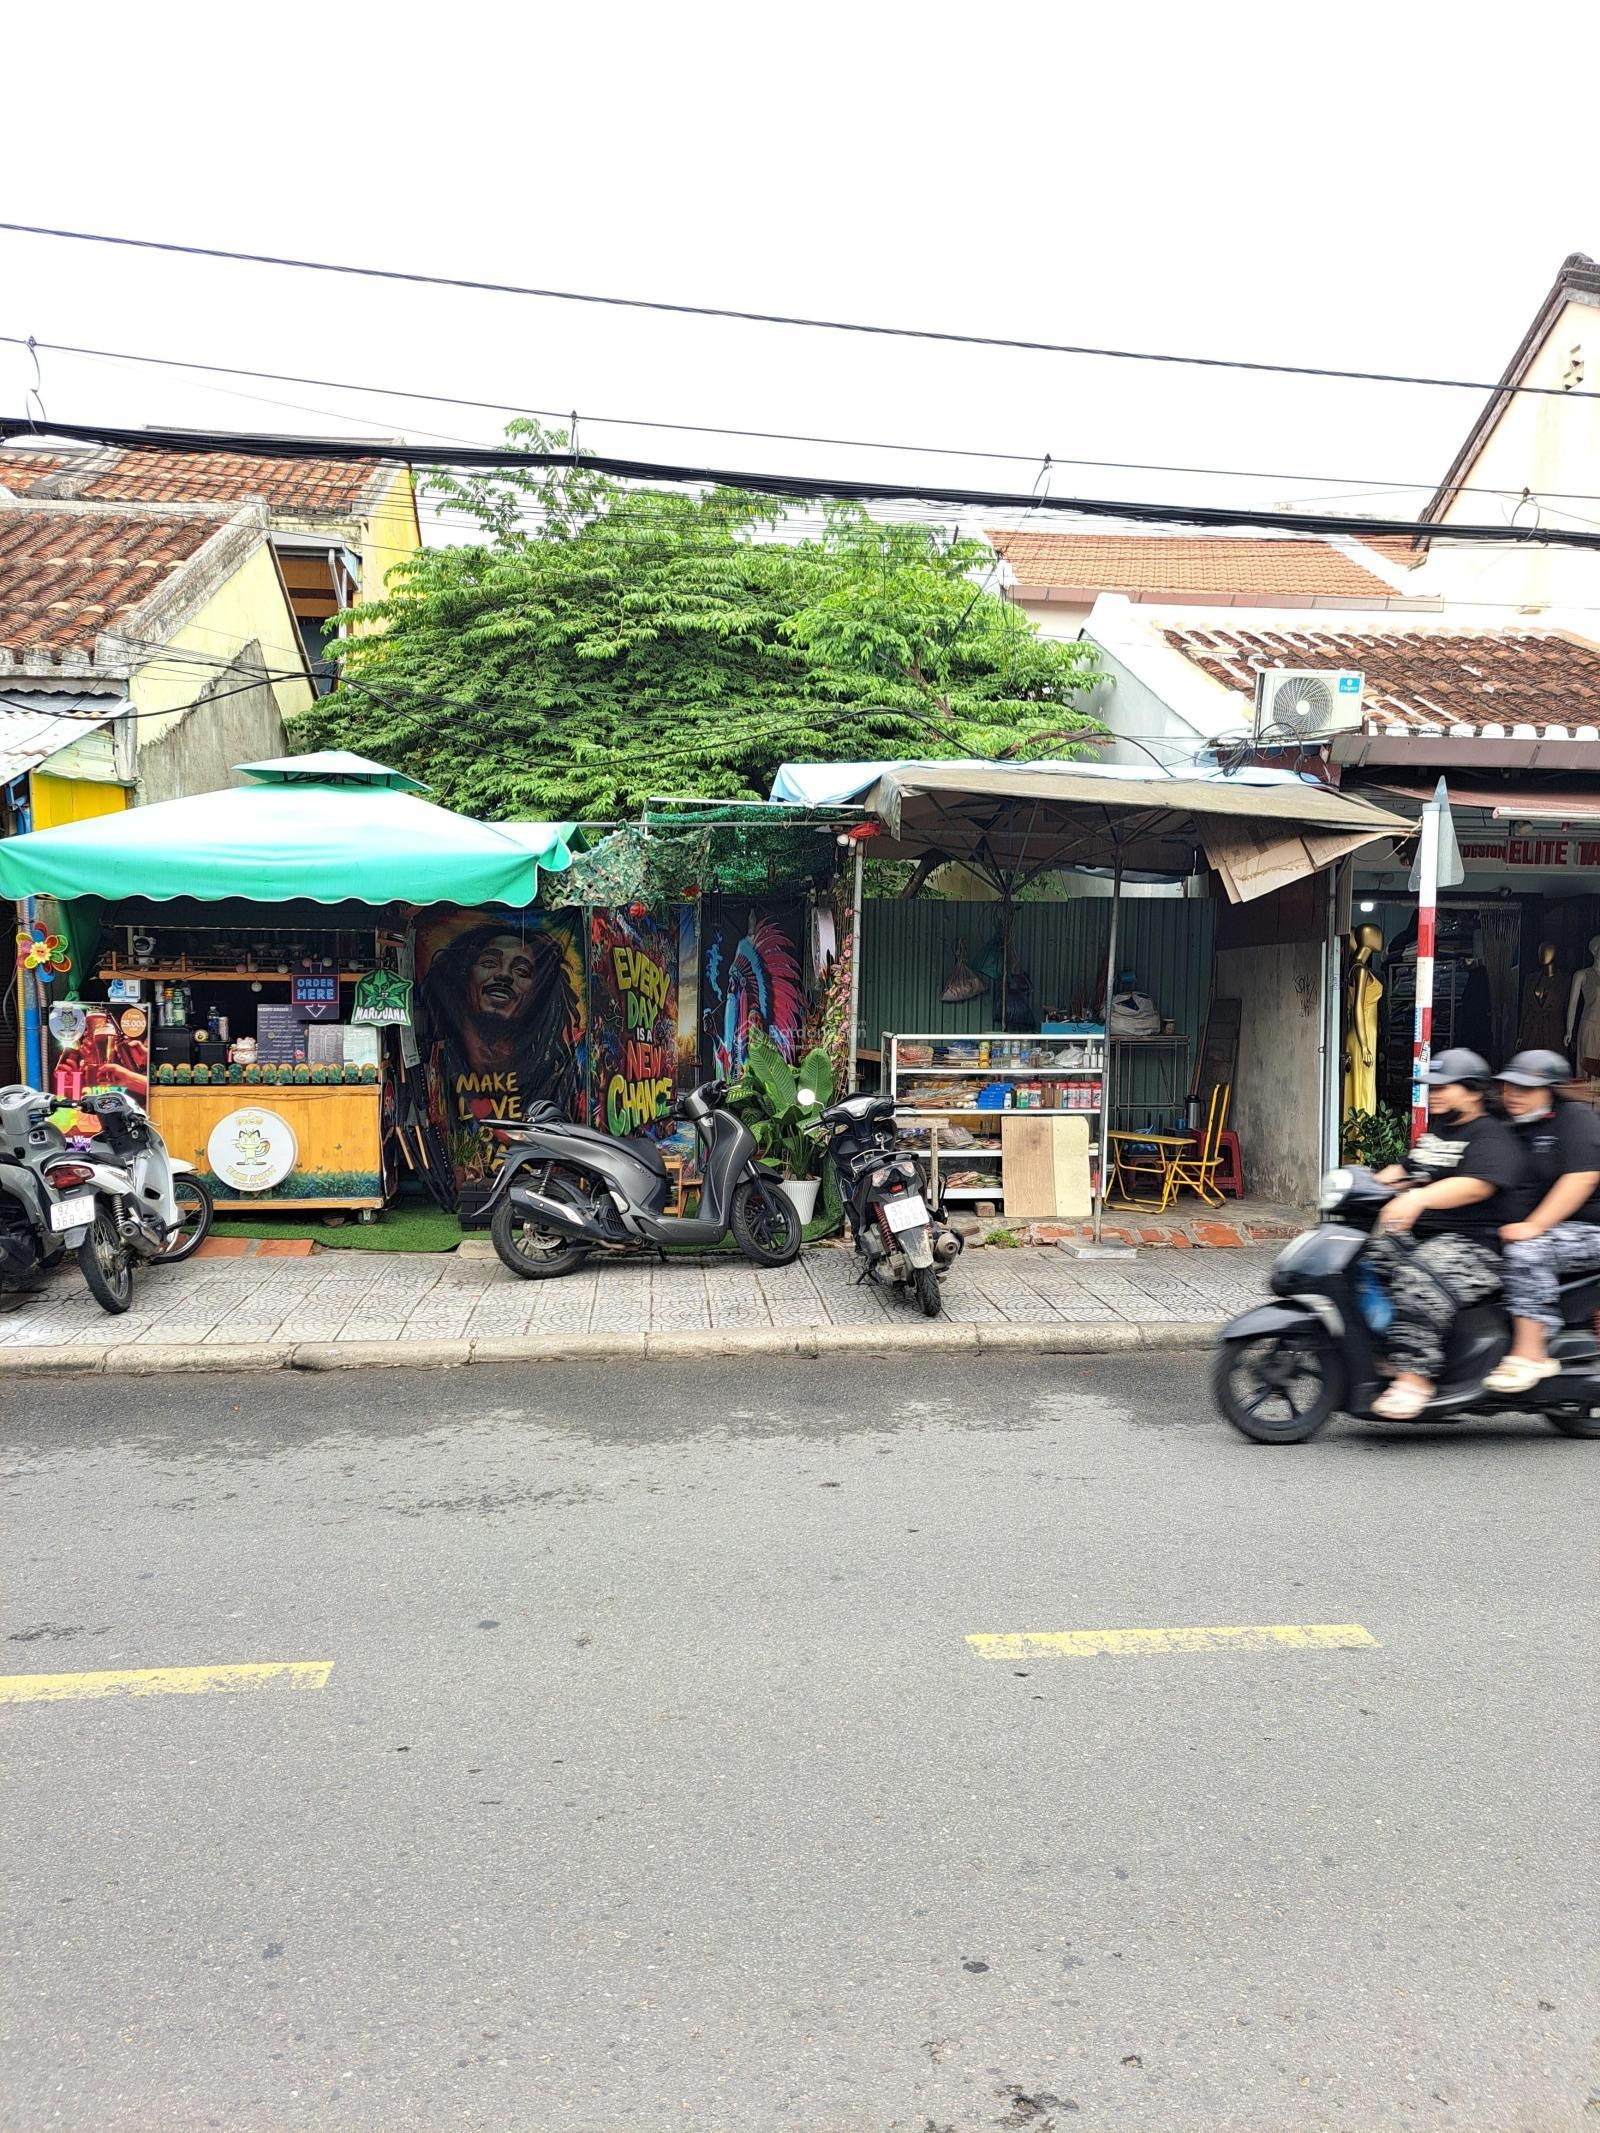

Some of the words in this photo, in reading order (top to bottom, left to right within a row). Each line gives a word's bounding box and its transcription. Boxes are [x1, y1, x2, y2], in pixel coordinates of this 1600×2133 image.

[1462, 844, 1505, 858] DESIGN
[1507, 840, 1568, 865] ELITE
[297, 978, 334, 988] ORDER
[613, 947, 671, 1009] EVERY
[297, 988, 334, 1000] HERE
[355, 1005, 407, 1022] MARIJUANA
[627, 991, 657, 1031] DAY
[637, 1028, 645, 1042] IS
[646, 1029, 653, 1042] A
[627, 1039, 662, 1081] NEW
[456, 1072, 519, 1094] MAKE
[607, 1074, 673, 1137] CHANCE
